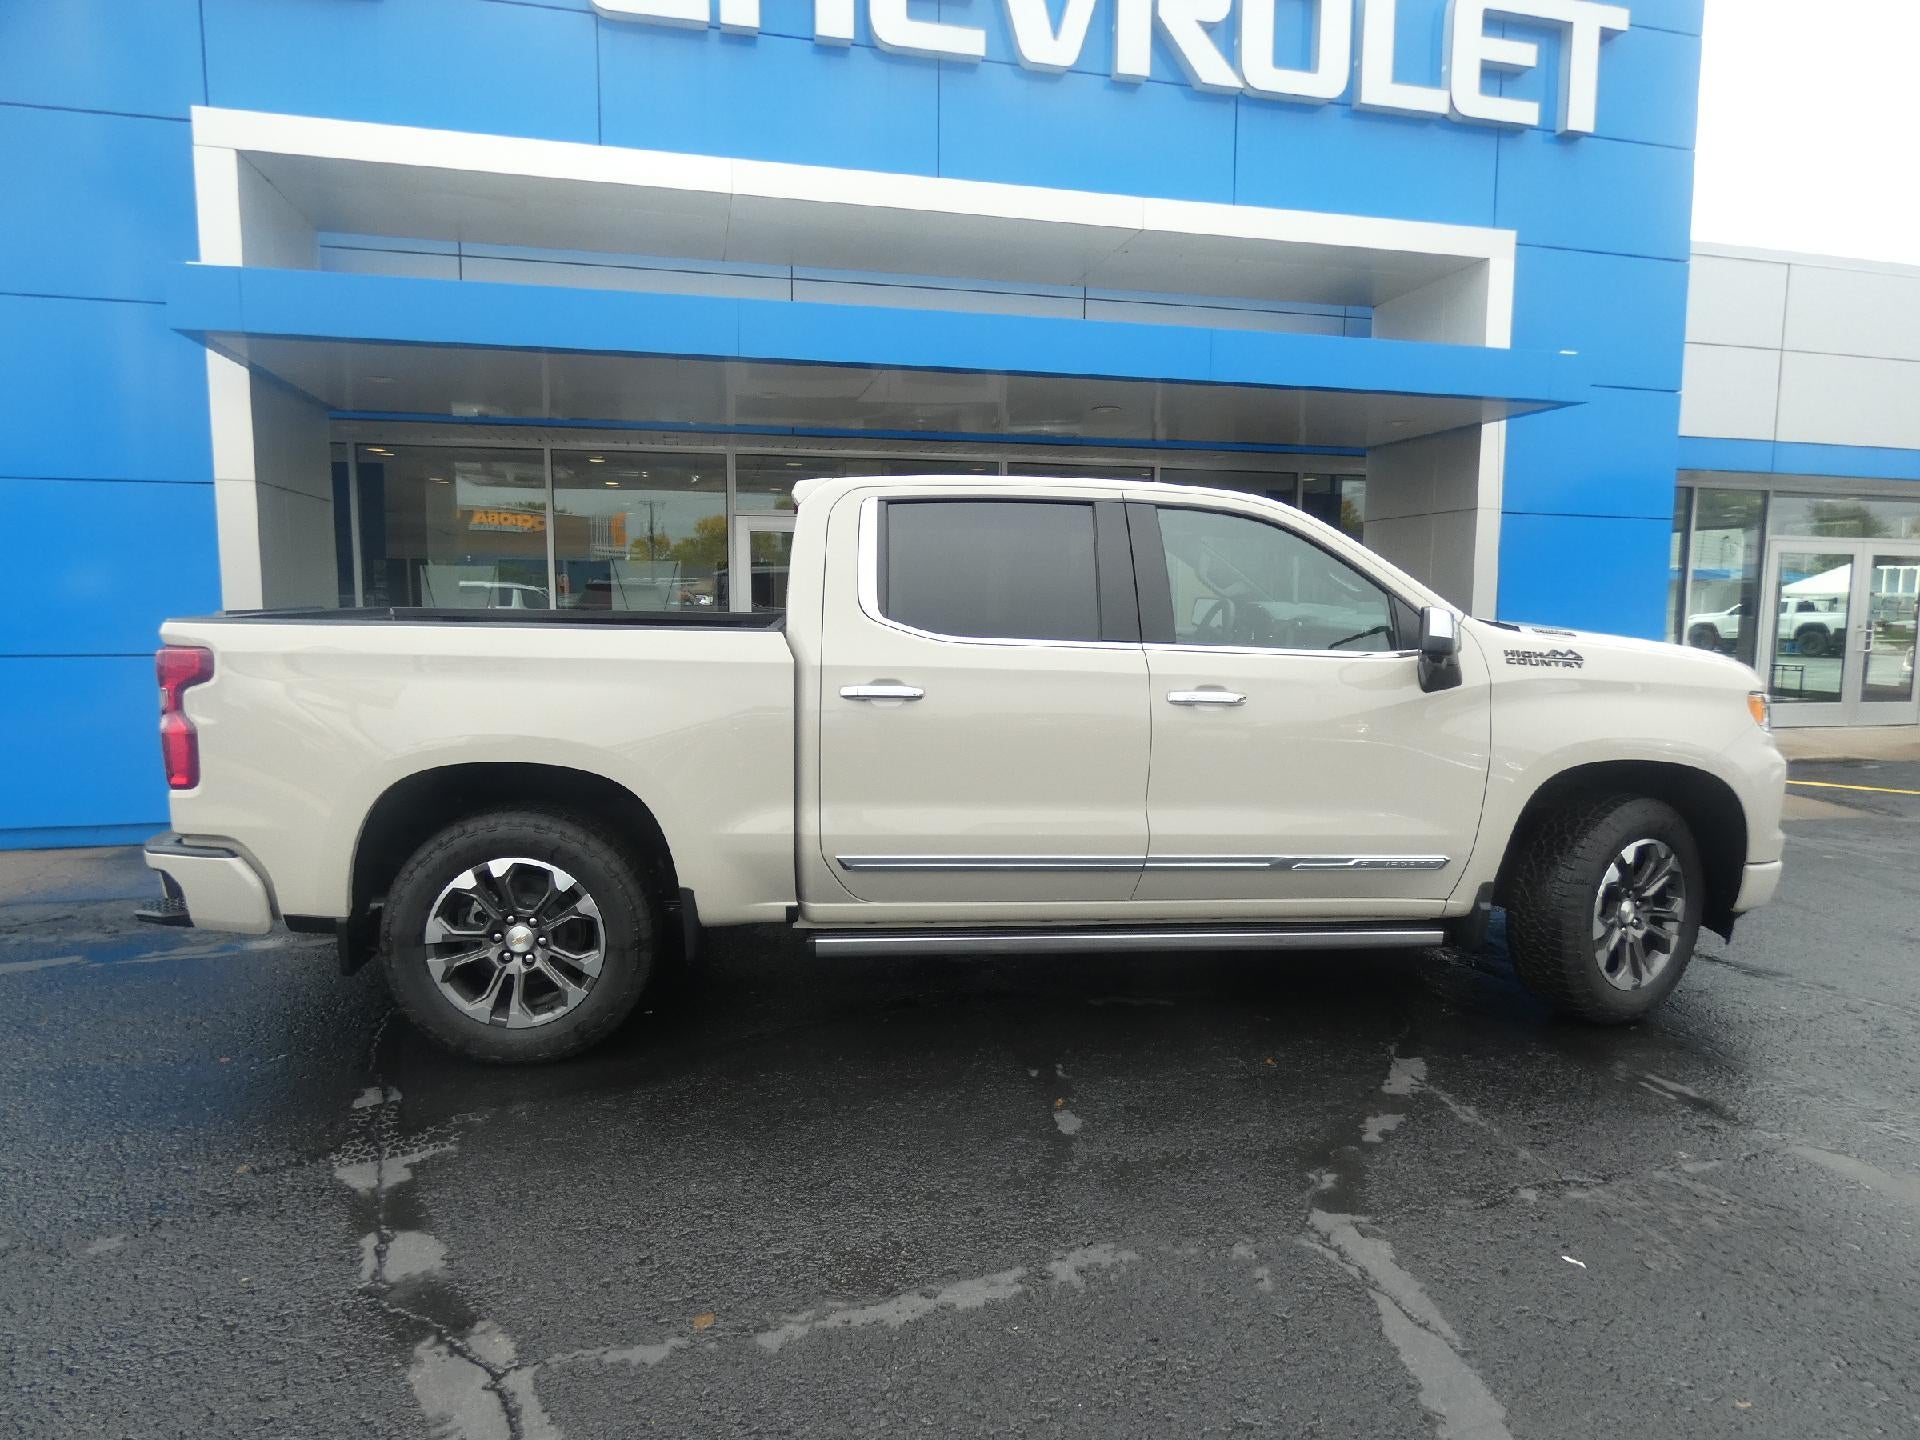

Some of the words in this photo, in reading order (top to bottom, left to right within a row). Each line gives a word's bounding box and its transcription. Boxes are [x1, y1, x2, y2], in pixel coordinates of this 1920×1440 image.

[592, 0, 1630, 134] VROLET
[1503, 649, 1546, 659] HIGH
[1505, 657, 1583, 669] COUNTRY
